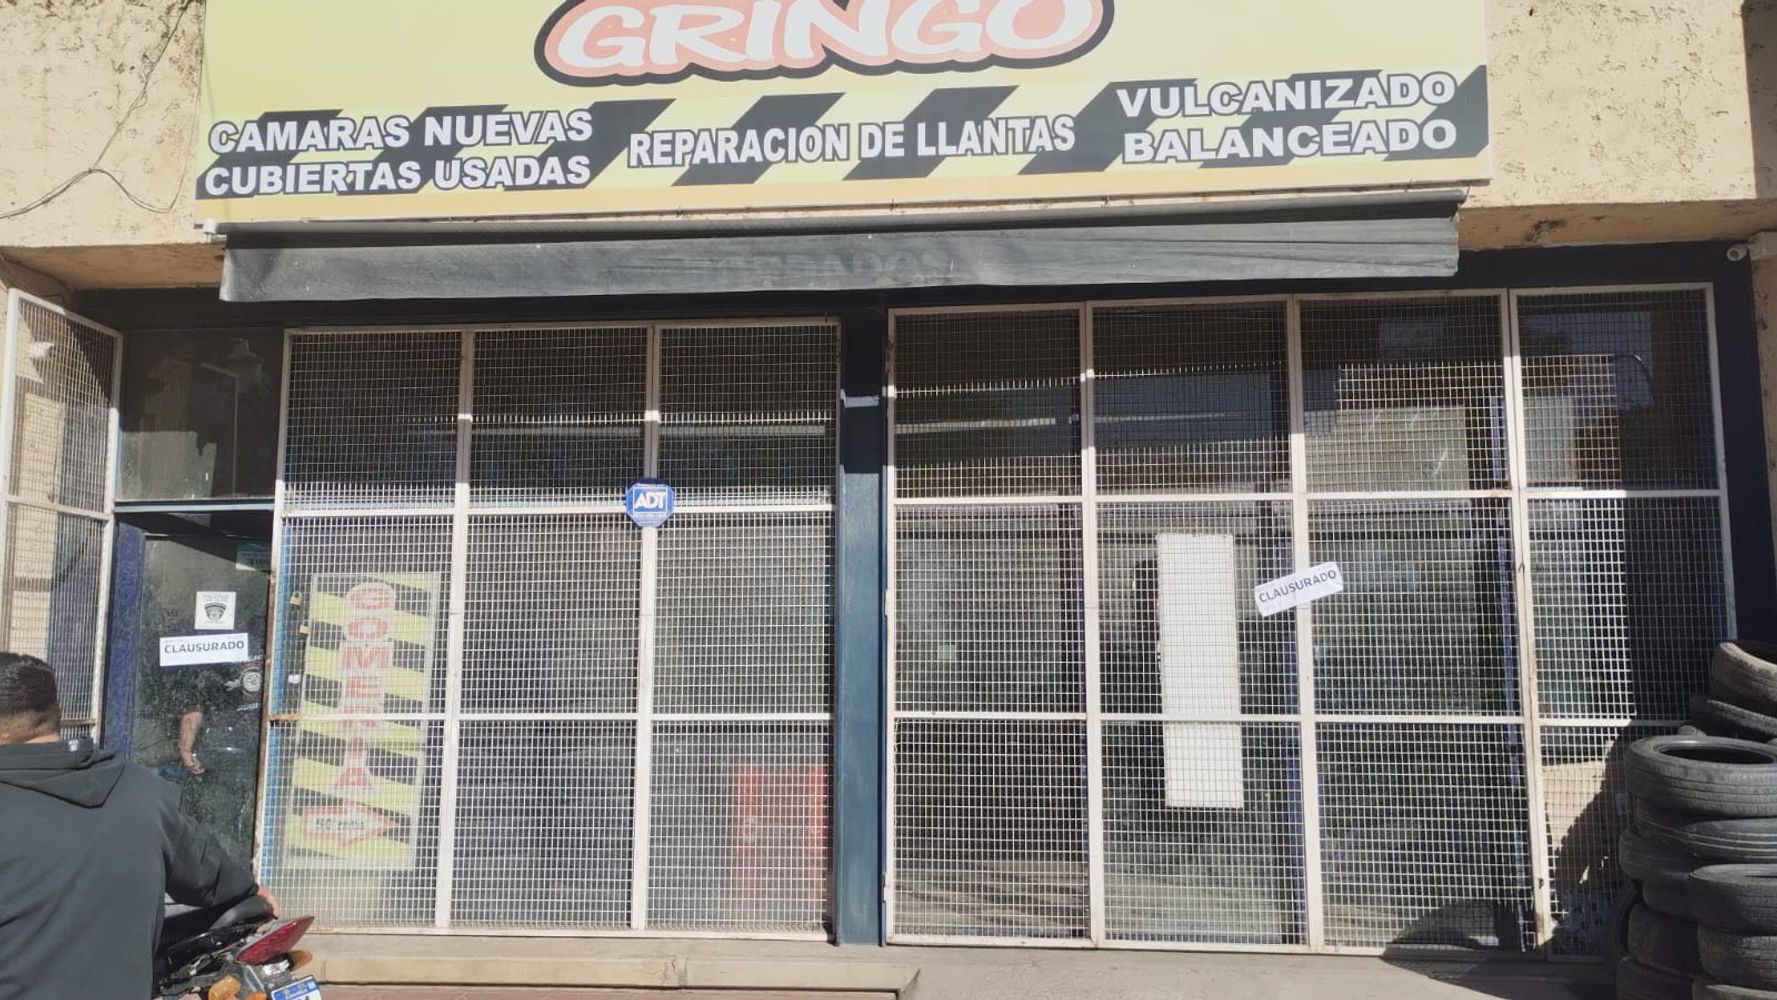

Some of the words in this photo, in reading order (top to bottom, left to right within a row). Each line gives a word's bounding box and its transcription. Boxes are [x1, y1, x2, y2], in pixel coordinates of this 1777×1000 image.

[557, 0, 1092, 67] GRINGO
[1116, 71, 1457, 119] VULCANIZADO
[208, 115, 411, 155] CAMARAS
[422, 108, 594, 147] NUEVAS
[627, 124, 850, 168] REPARACION
[860, 121, 906, 159] DE
[915, 114, 1076, 157] LLANTAS
[1122, 117, 1458, 165] BALANCEADO
[203, 159, 422, 197] CUBIERTAS
[433, 154, 592, 189] USADAS
[634, 491, 666, 509] ADT
[1258, 569, 1337, 603] CLAUSURADO
[163, 640, 245, 655] CLAUSURADO
[339, 585, 393, 791] GOMERIA
